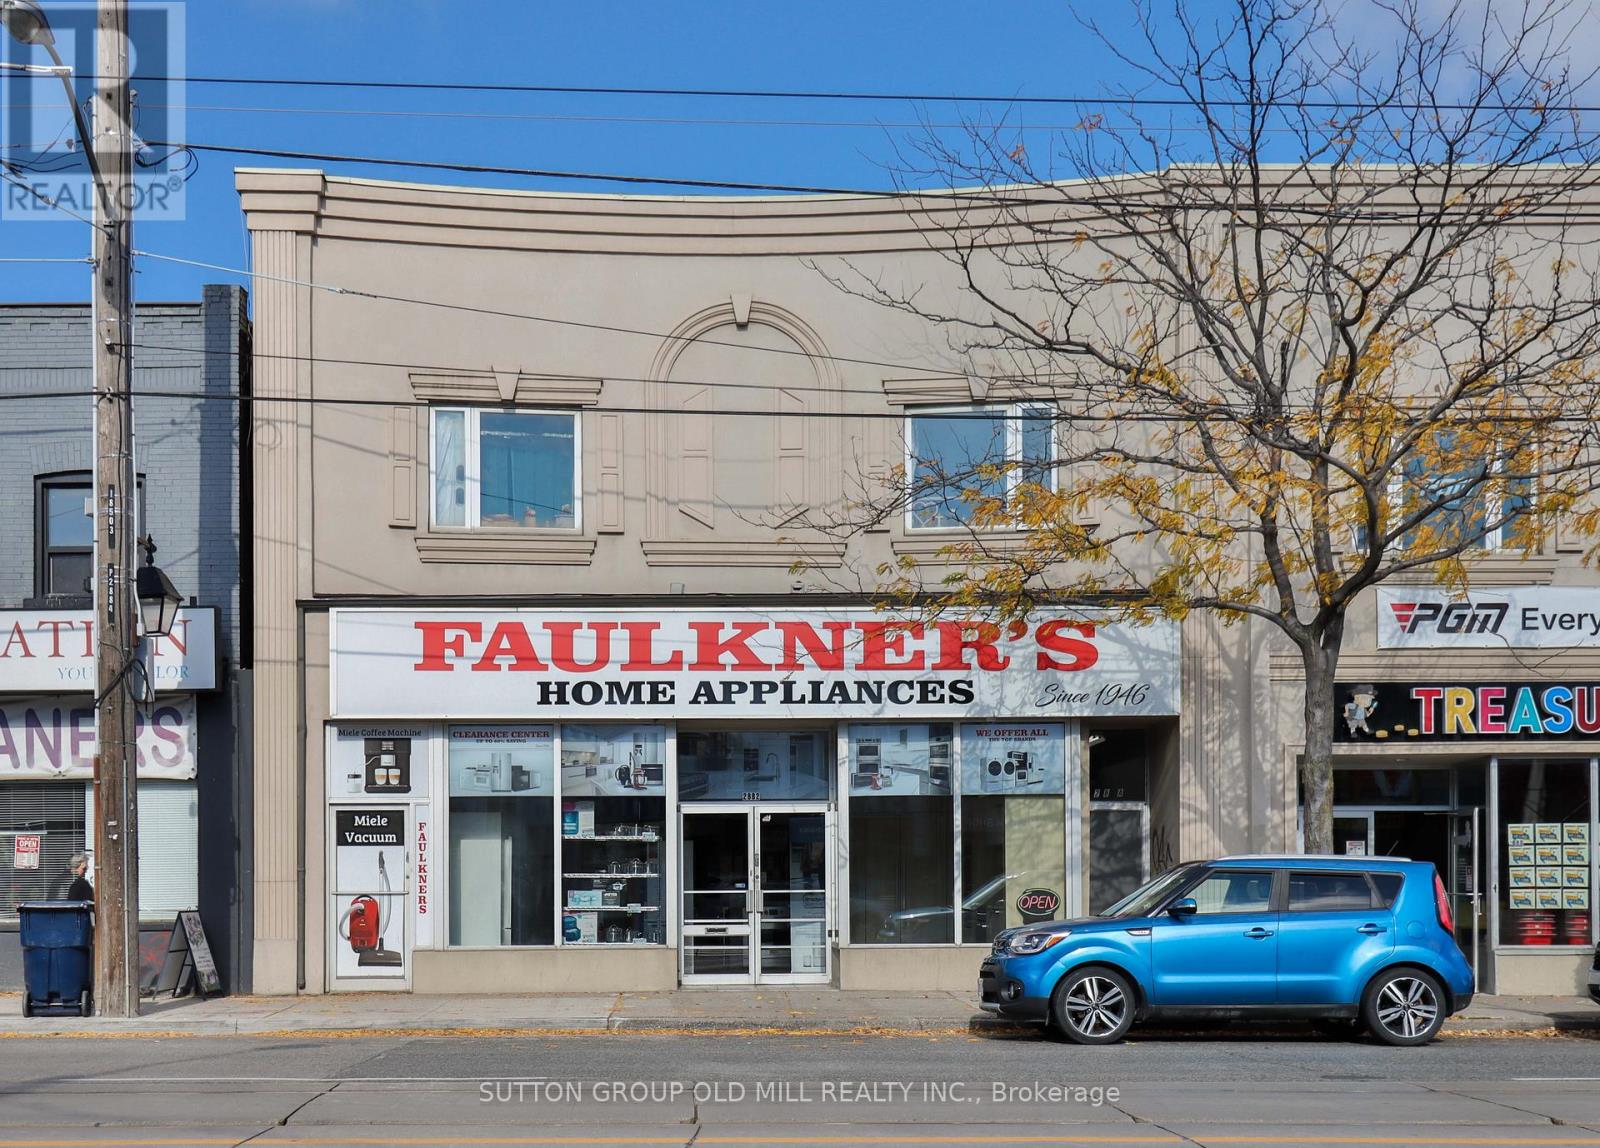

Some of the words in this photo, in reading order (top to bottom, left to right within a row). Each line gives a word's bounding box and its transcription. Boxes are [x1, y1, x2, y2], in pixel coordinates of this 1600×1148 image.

[1521, 607, 1600, 636] Every
[0, 620, 192, 657] ATIN
[413, 619, 1100, 672] FAULKNER'S
[536, 680, 676, 706] HOME
[689, 679, 975, 706] APPLIANCES
[1034, 682, 1090, 708] Since
[1094, 683, 1151, 707] 1946
[1412, 686, 1600, 734] TREASU
[338, 729, 360, 737] Miele
[361, 729, 387, 737] Coffee
[387, 729, 422, 737] Machine
[976, 729, 992, 737] WE
[993, 729, 1027, 737] OFFER
[1030, 728, 1049, 737] ALL
[353, 815, 388, 826] Miele
[19, 840, 37, 848] OPEN
[345, 832, 397, 843] Vacuum
[418, 822, 428, 914] FAULKNERS
[1020, 895, 1056, 909] OPEN
